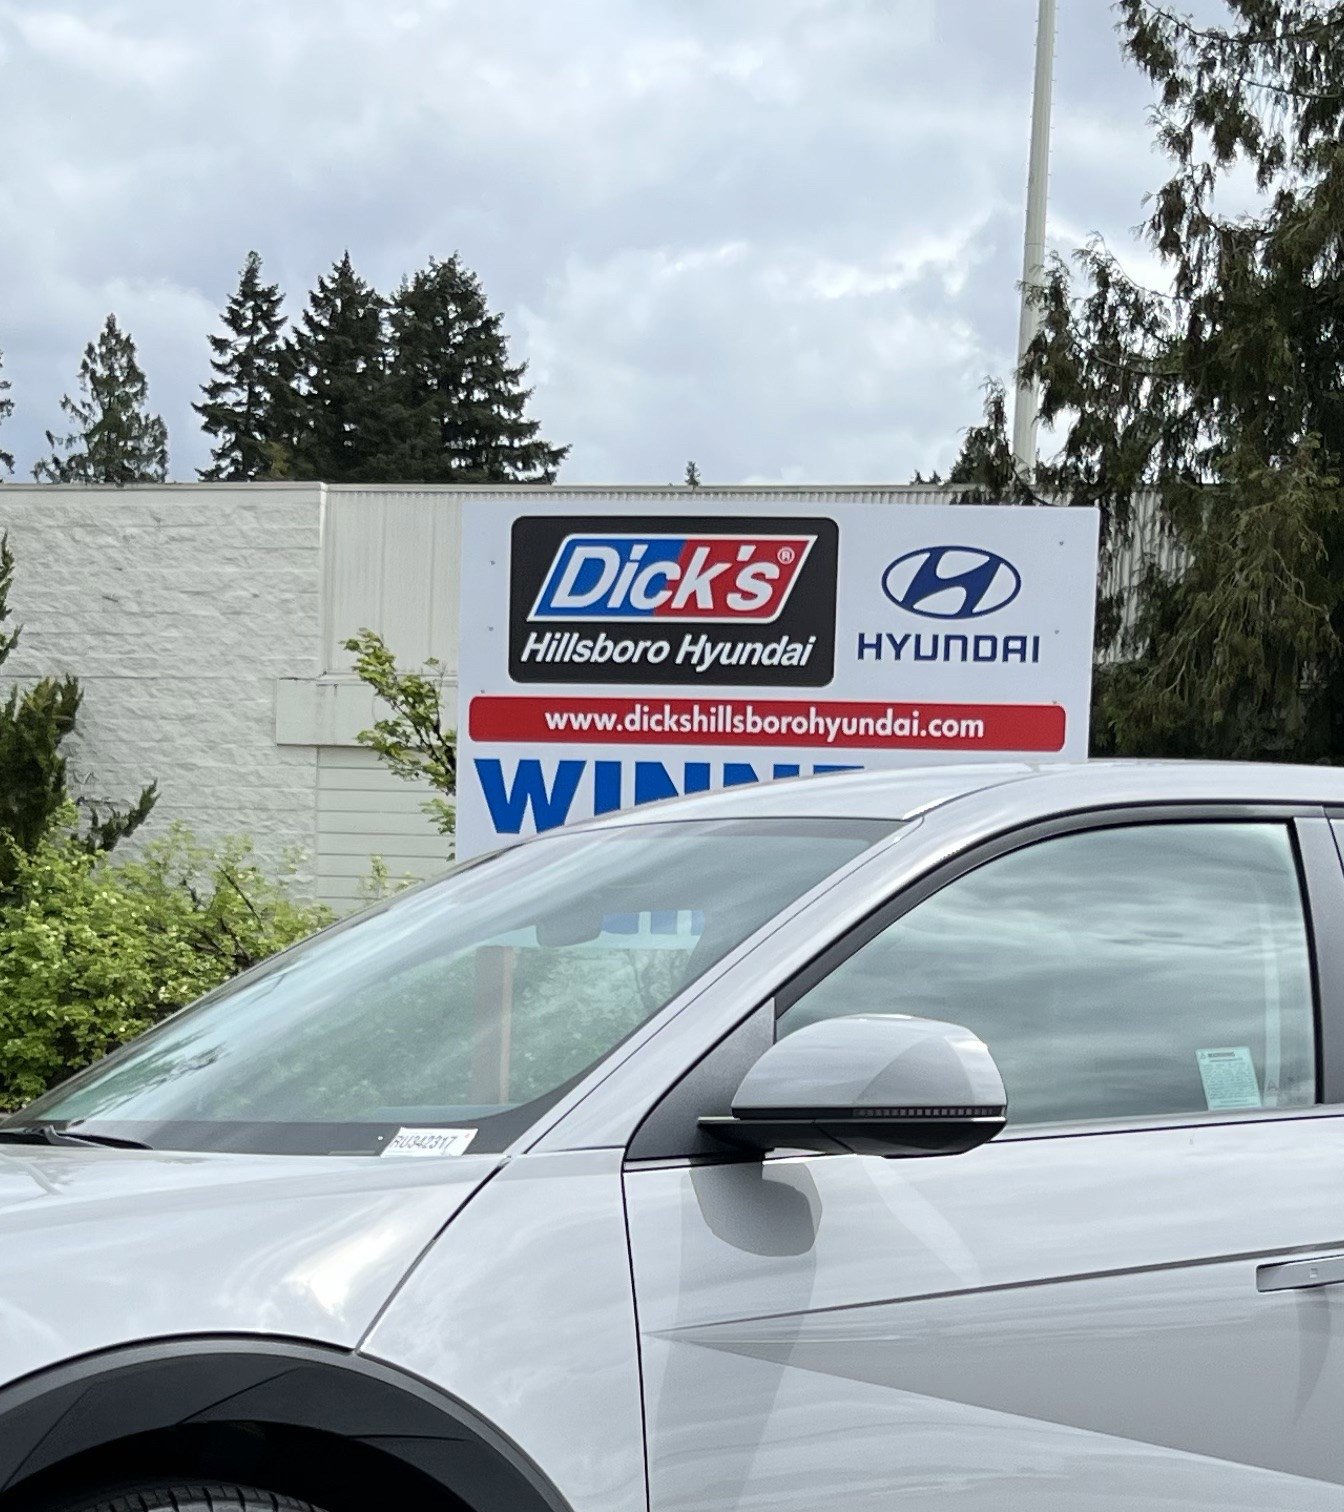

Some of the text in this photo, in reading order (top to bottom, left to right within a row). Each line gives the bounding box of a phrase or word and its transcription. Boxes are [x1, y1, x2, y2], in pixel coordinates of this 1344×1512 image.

[550, 544, 780, 612] Dick's
[520, 631, 818, 673] Hillsboro Hyundai
[857, 632, 1041, 664] HYUNDAI
[544, 704, 985, 743] www.dickshillsborohyundai.com
